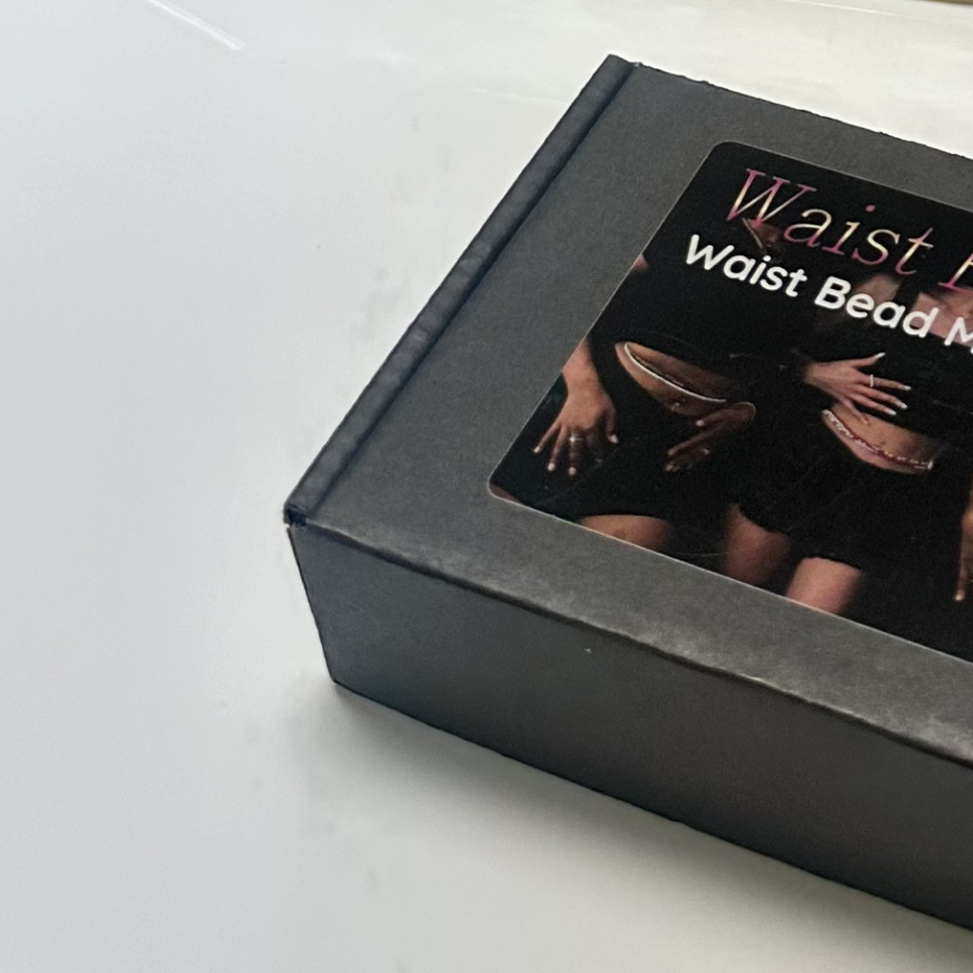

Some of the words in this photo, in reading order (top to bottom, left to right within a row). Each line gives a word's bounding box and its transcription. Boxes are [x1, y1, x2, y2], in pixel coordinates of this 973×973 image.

[725, 167, 934, 276] Waist
[684, 233, 808, 299] Waist
[813, 274, 938, 340] Bead
